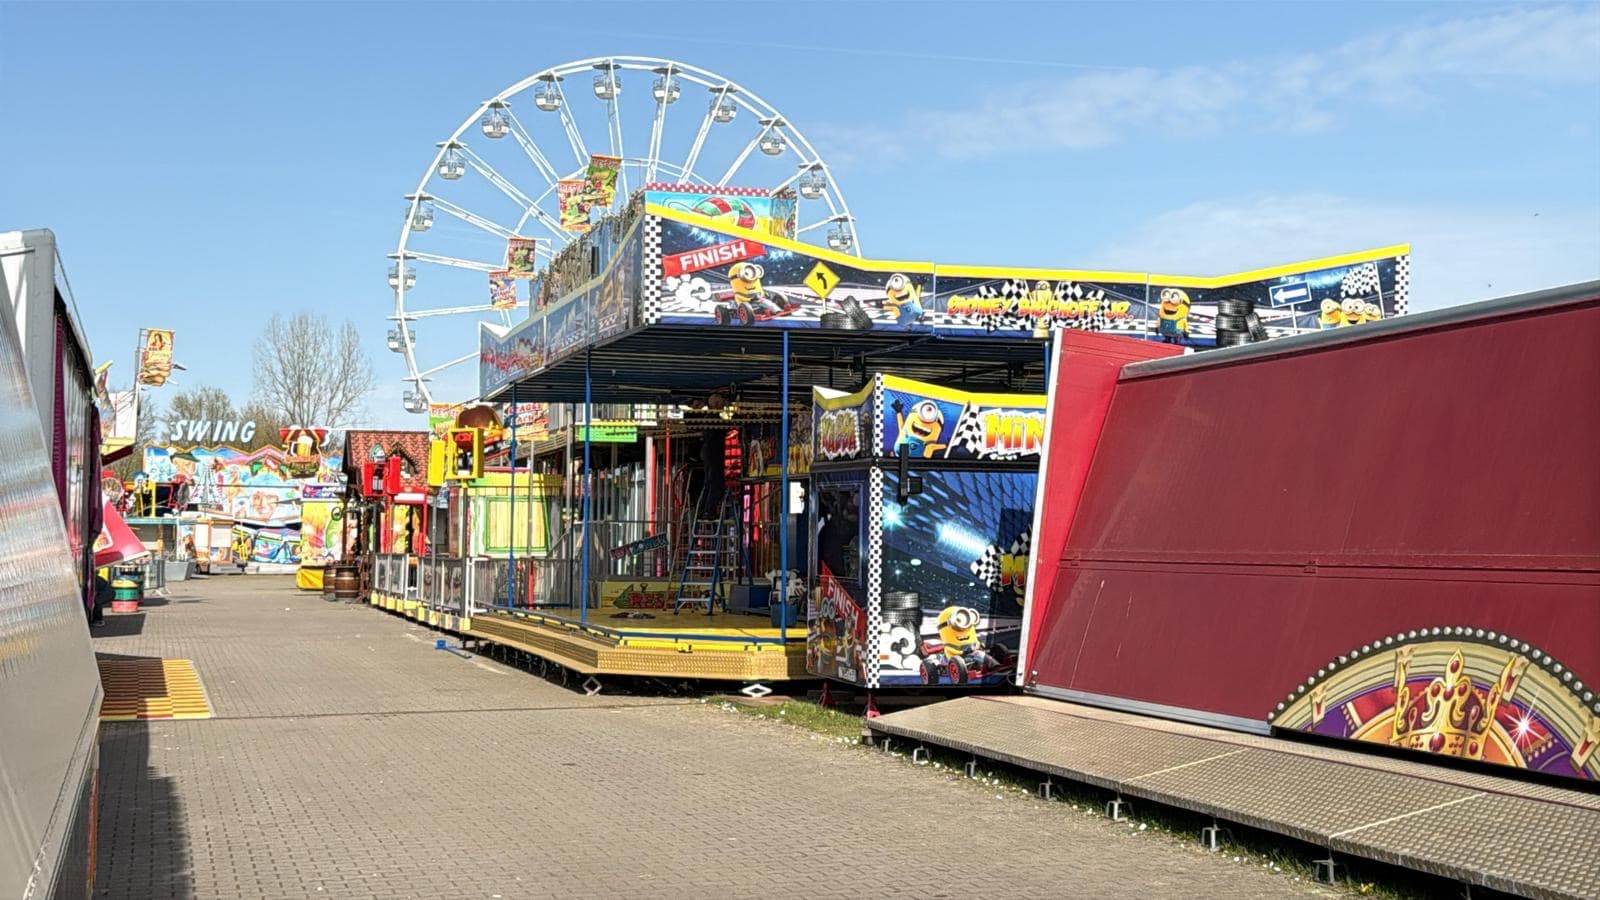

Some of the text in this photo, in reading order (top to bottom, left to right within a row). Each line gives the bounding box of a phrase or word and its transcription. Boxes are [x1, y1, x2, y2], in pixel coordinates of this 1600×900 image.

[680, 242, 747, 270] FINISH
[171, 420, 256, 443] SWING
[827, 576, 860, 630] FINISH
